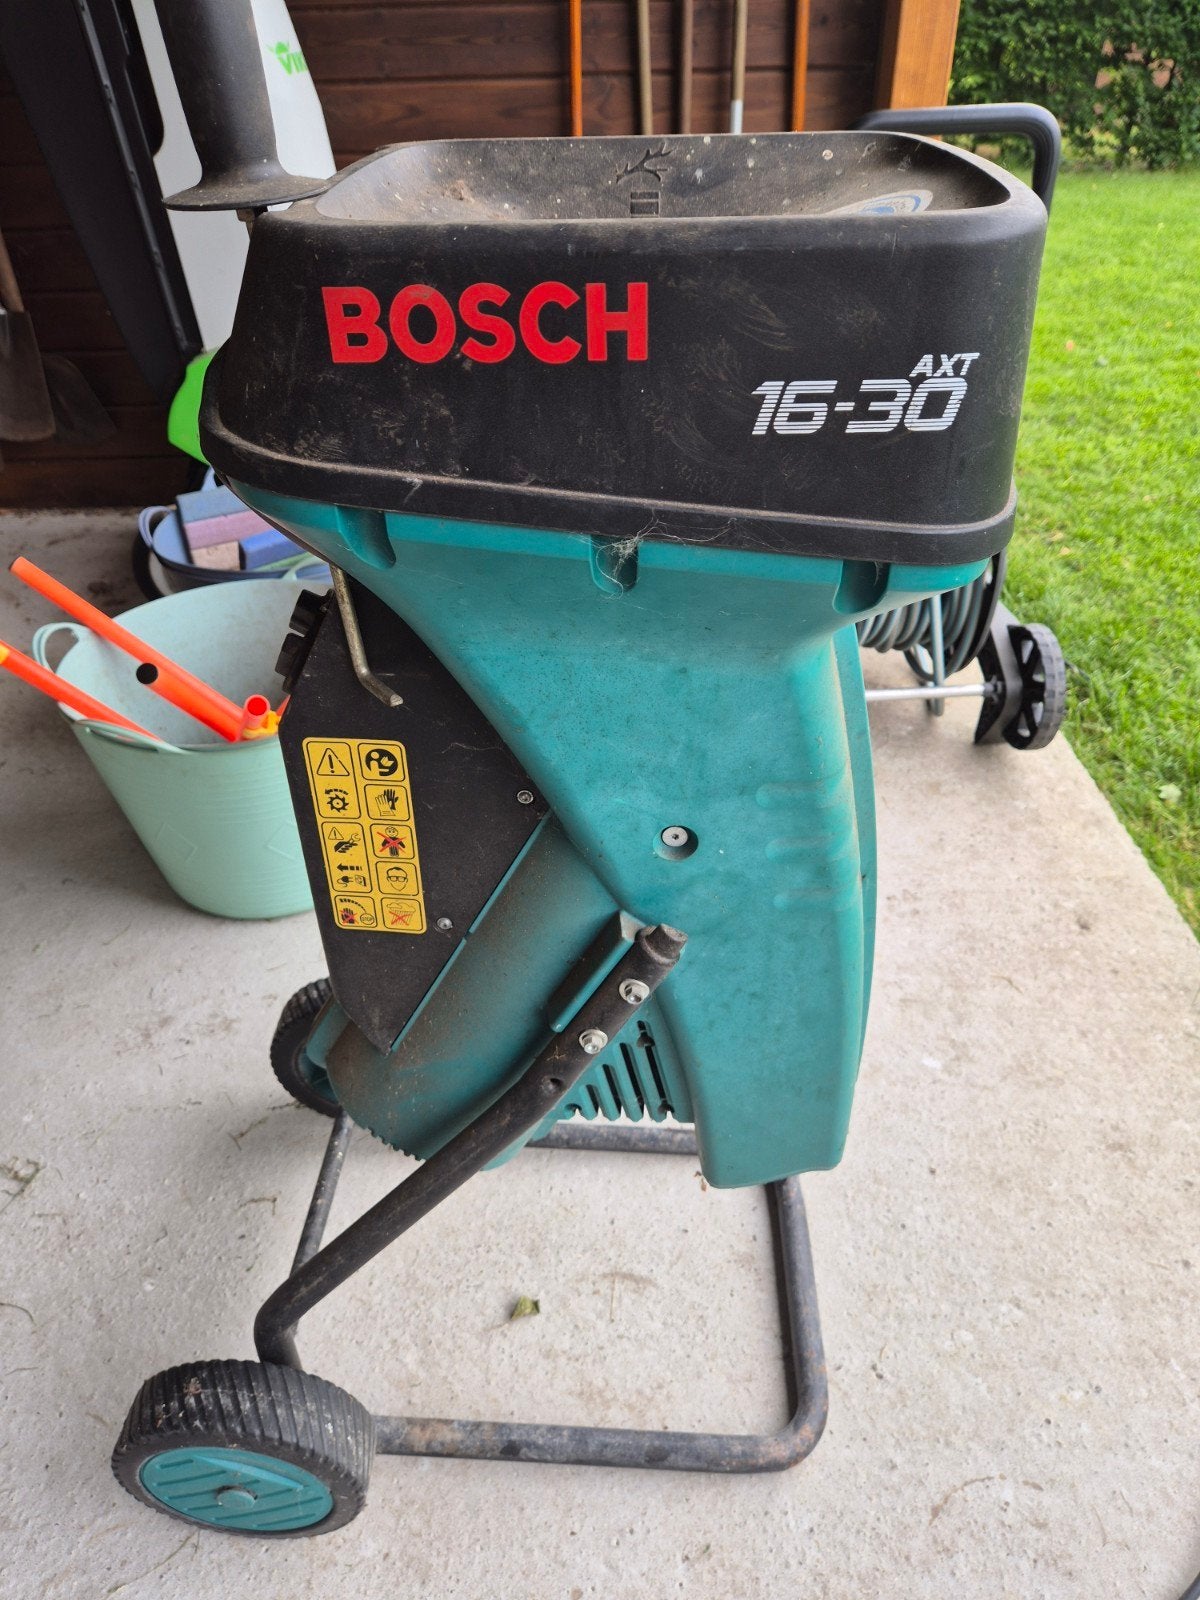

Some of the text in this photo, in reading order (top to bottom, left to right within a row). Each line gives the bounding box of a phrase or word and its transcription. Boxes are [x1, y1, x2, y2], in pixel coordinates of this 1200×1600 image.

[321, 281, 648, 364] BOSCH
[909, 352, 980, 377] AXT
[751, 377, 968, 435] 16-30
